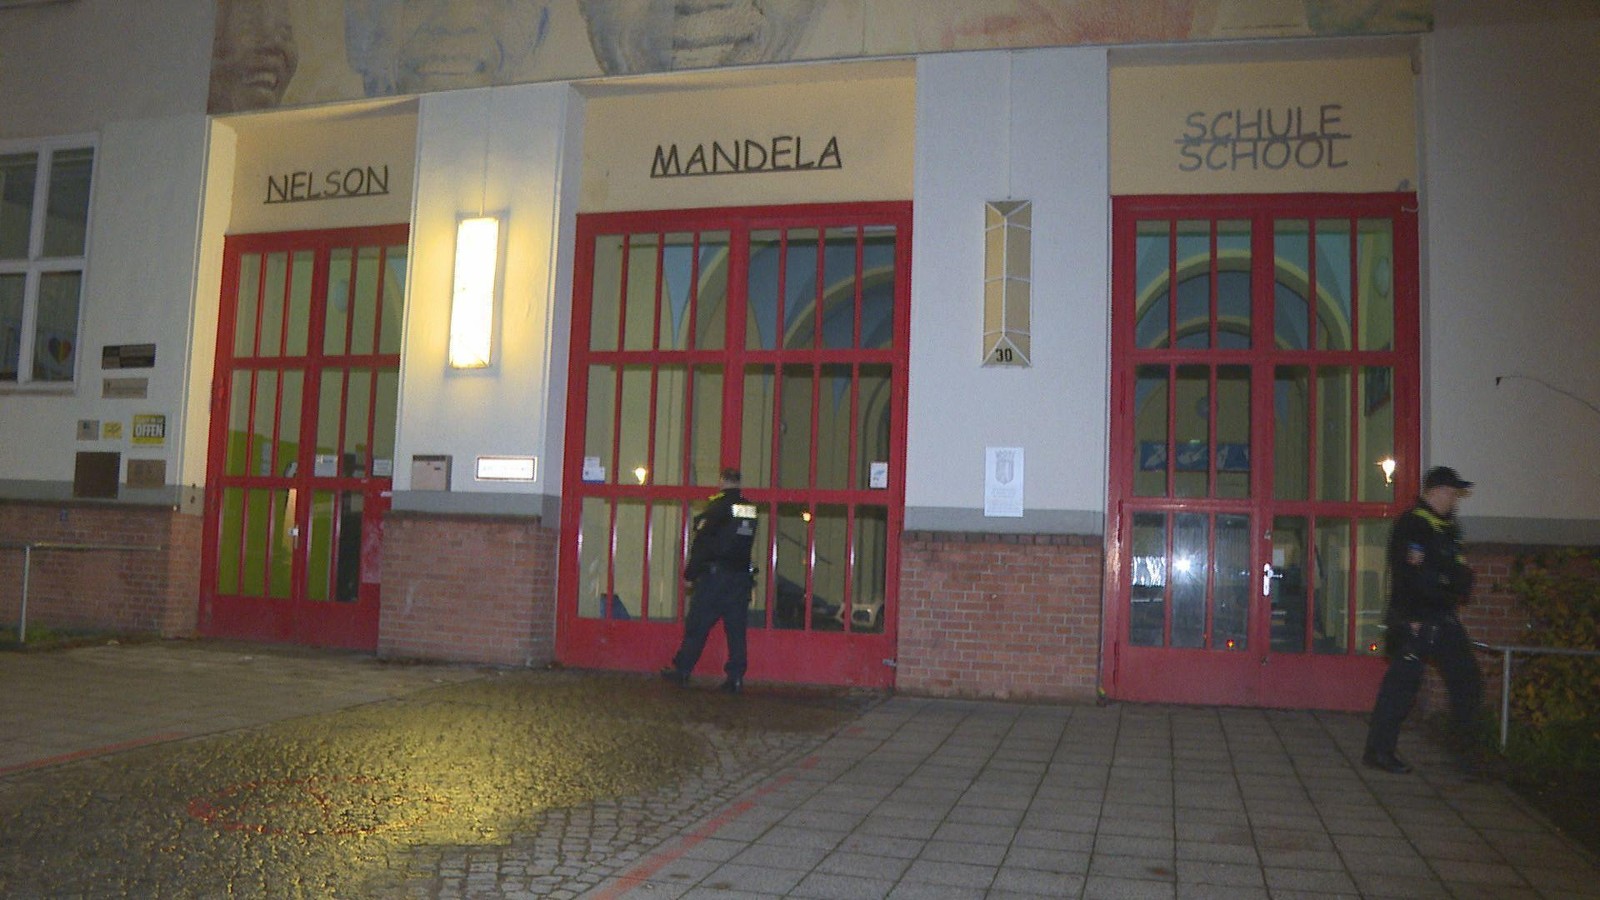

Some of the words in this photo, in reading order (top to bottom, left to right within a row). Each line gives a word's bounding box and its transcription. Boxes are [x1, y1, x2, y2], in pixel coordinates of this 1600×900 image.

[1183, 104, 1344, 142] SCHULE
[650, 135, 842, 178] MANDELA
[1178, 138, 1349, 172] SCHOOL
[264, 164, 389, 204] NELSON
[995, 347, 1013, 363] 30
[135, 423, 163, 437] OFFEN
